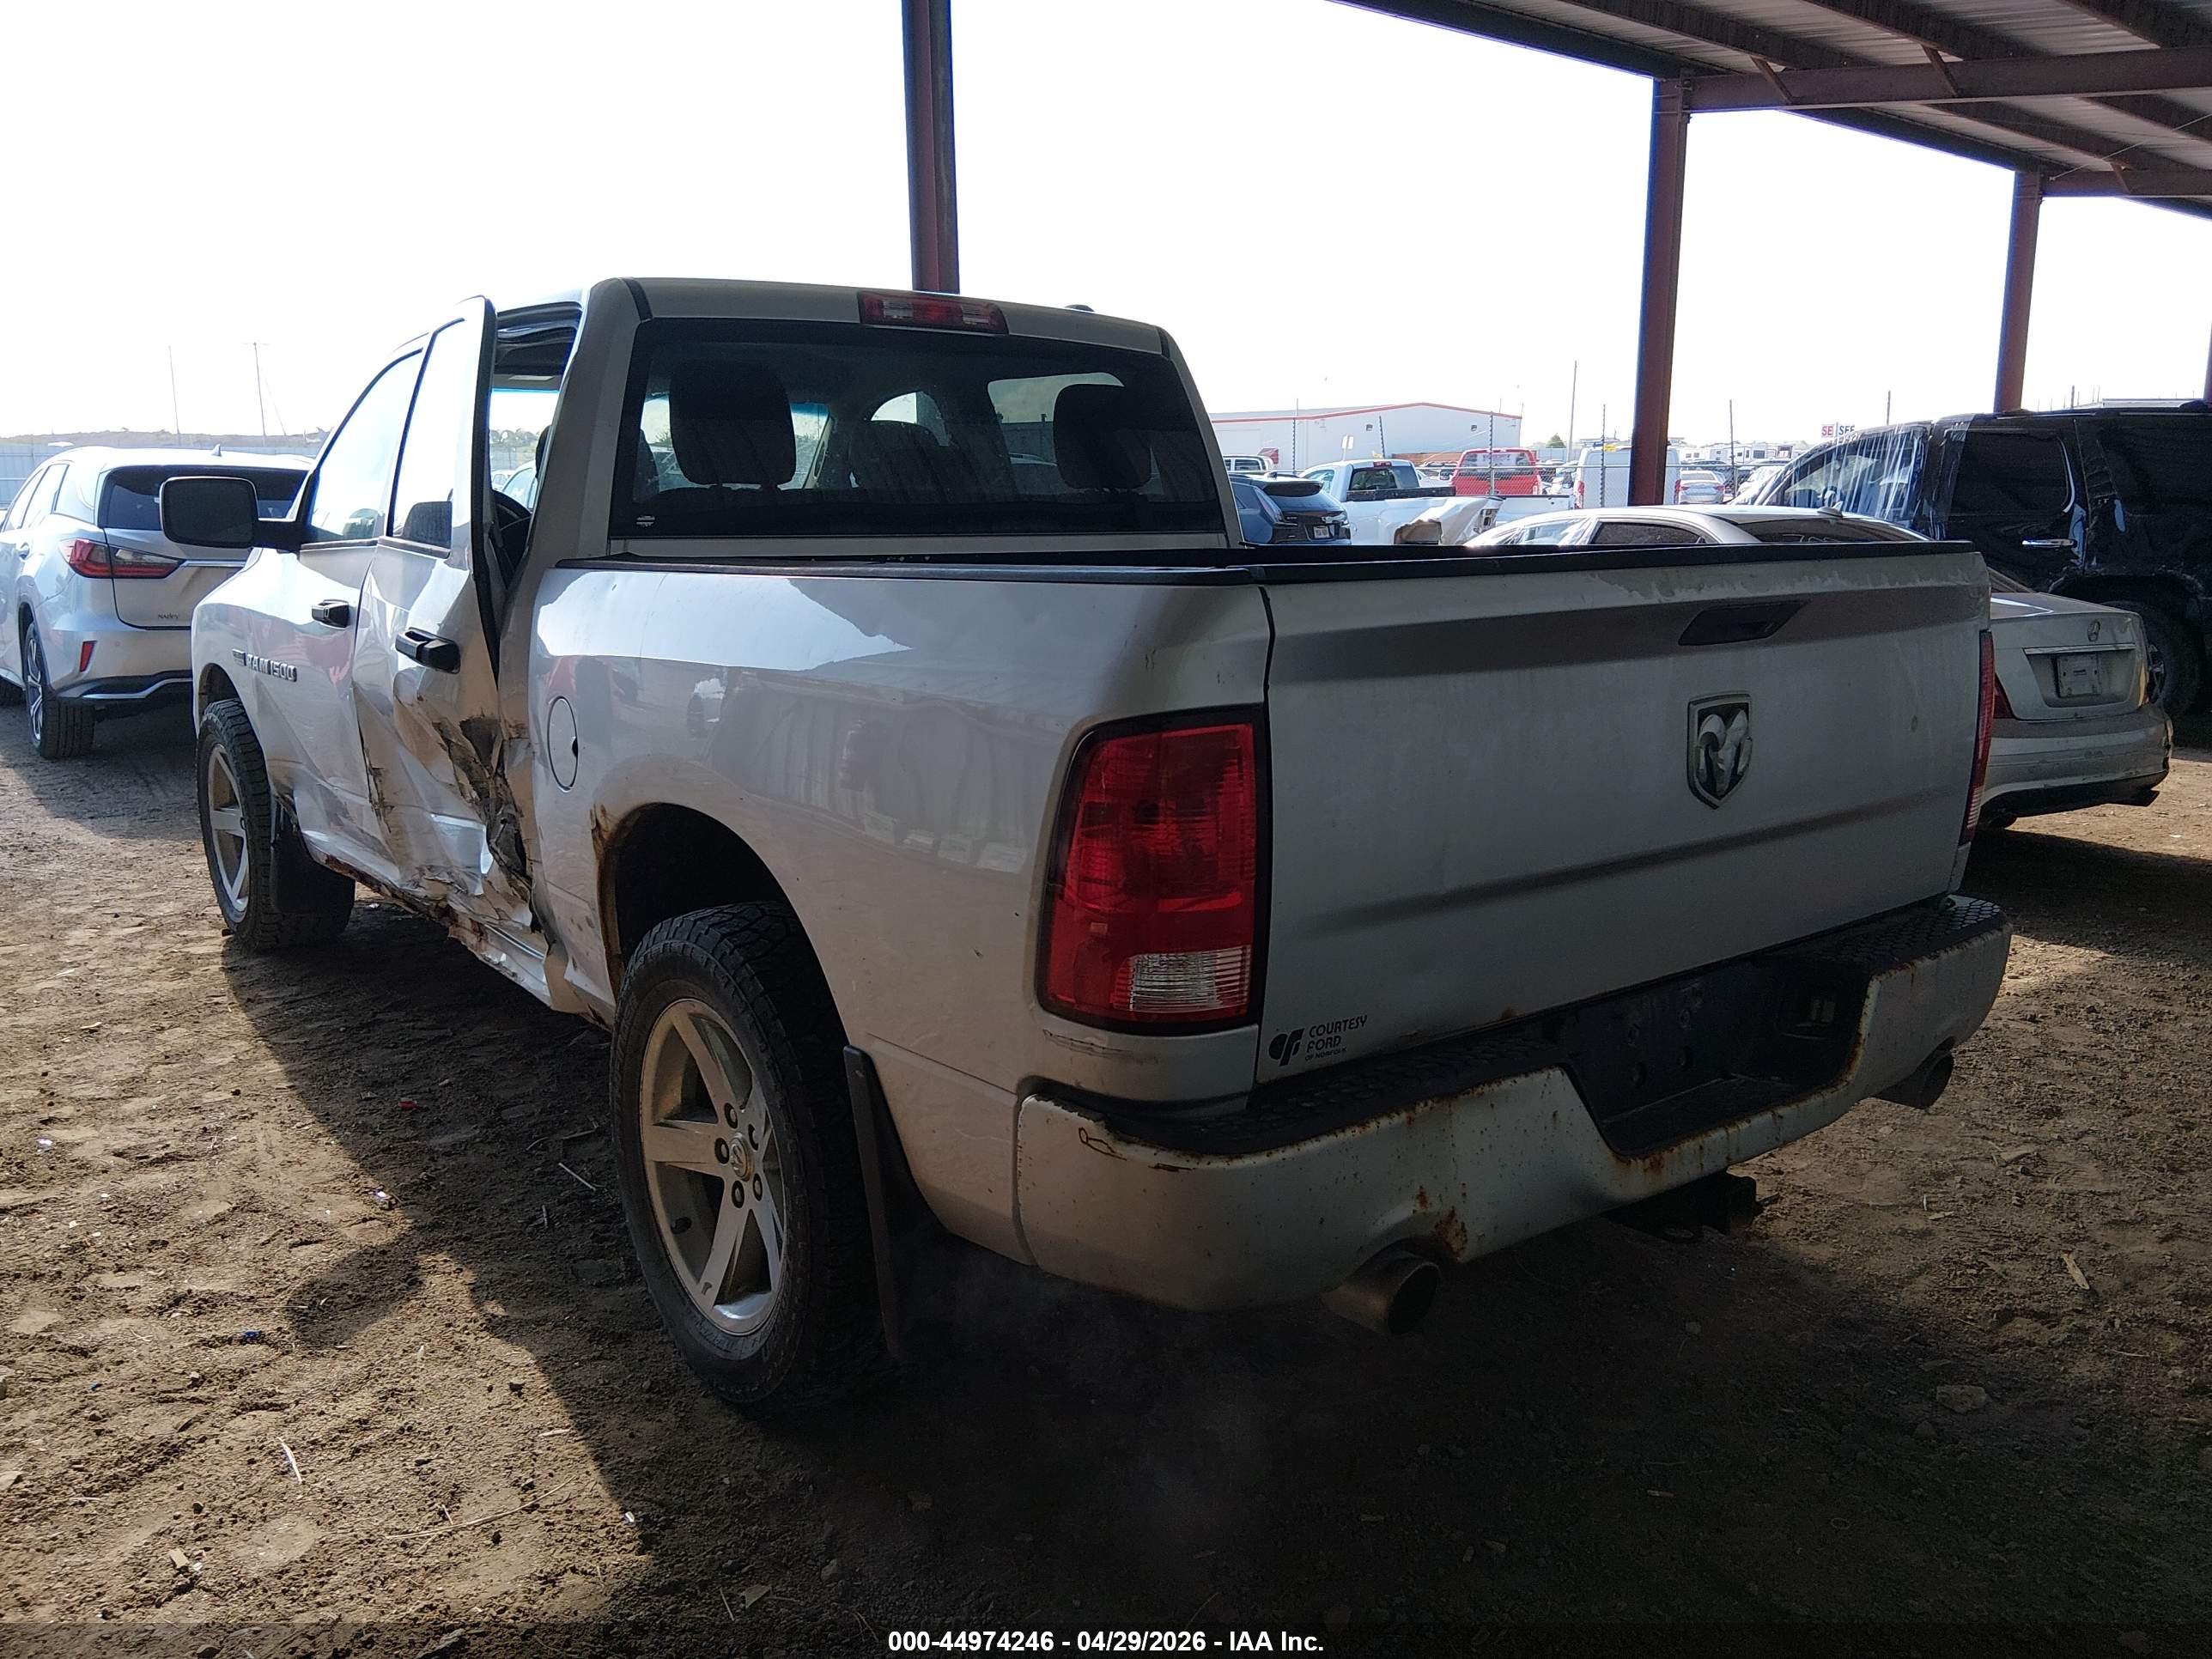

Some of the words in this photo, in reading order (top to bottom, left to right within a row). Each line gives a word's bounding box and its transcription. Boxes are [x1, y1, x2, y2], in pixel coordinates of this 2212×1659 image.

[247, 653, 270, 674] RAM
[270, 660, 297, 682] 1500
[1310, 1015, 1367, 1037] COURTESY
[1306, 1036, 1341, 1053] FORD
